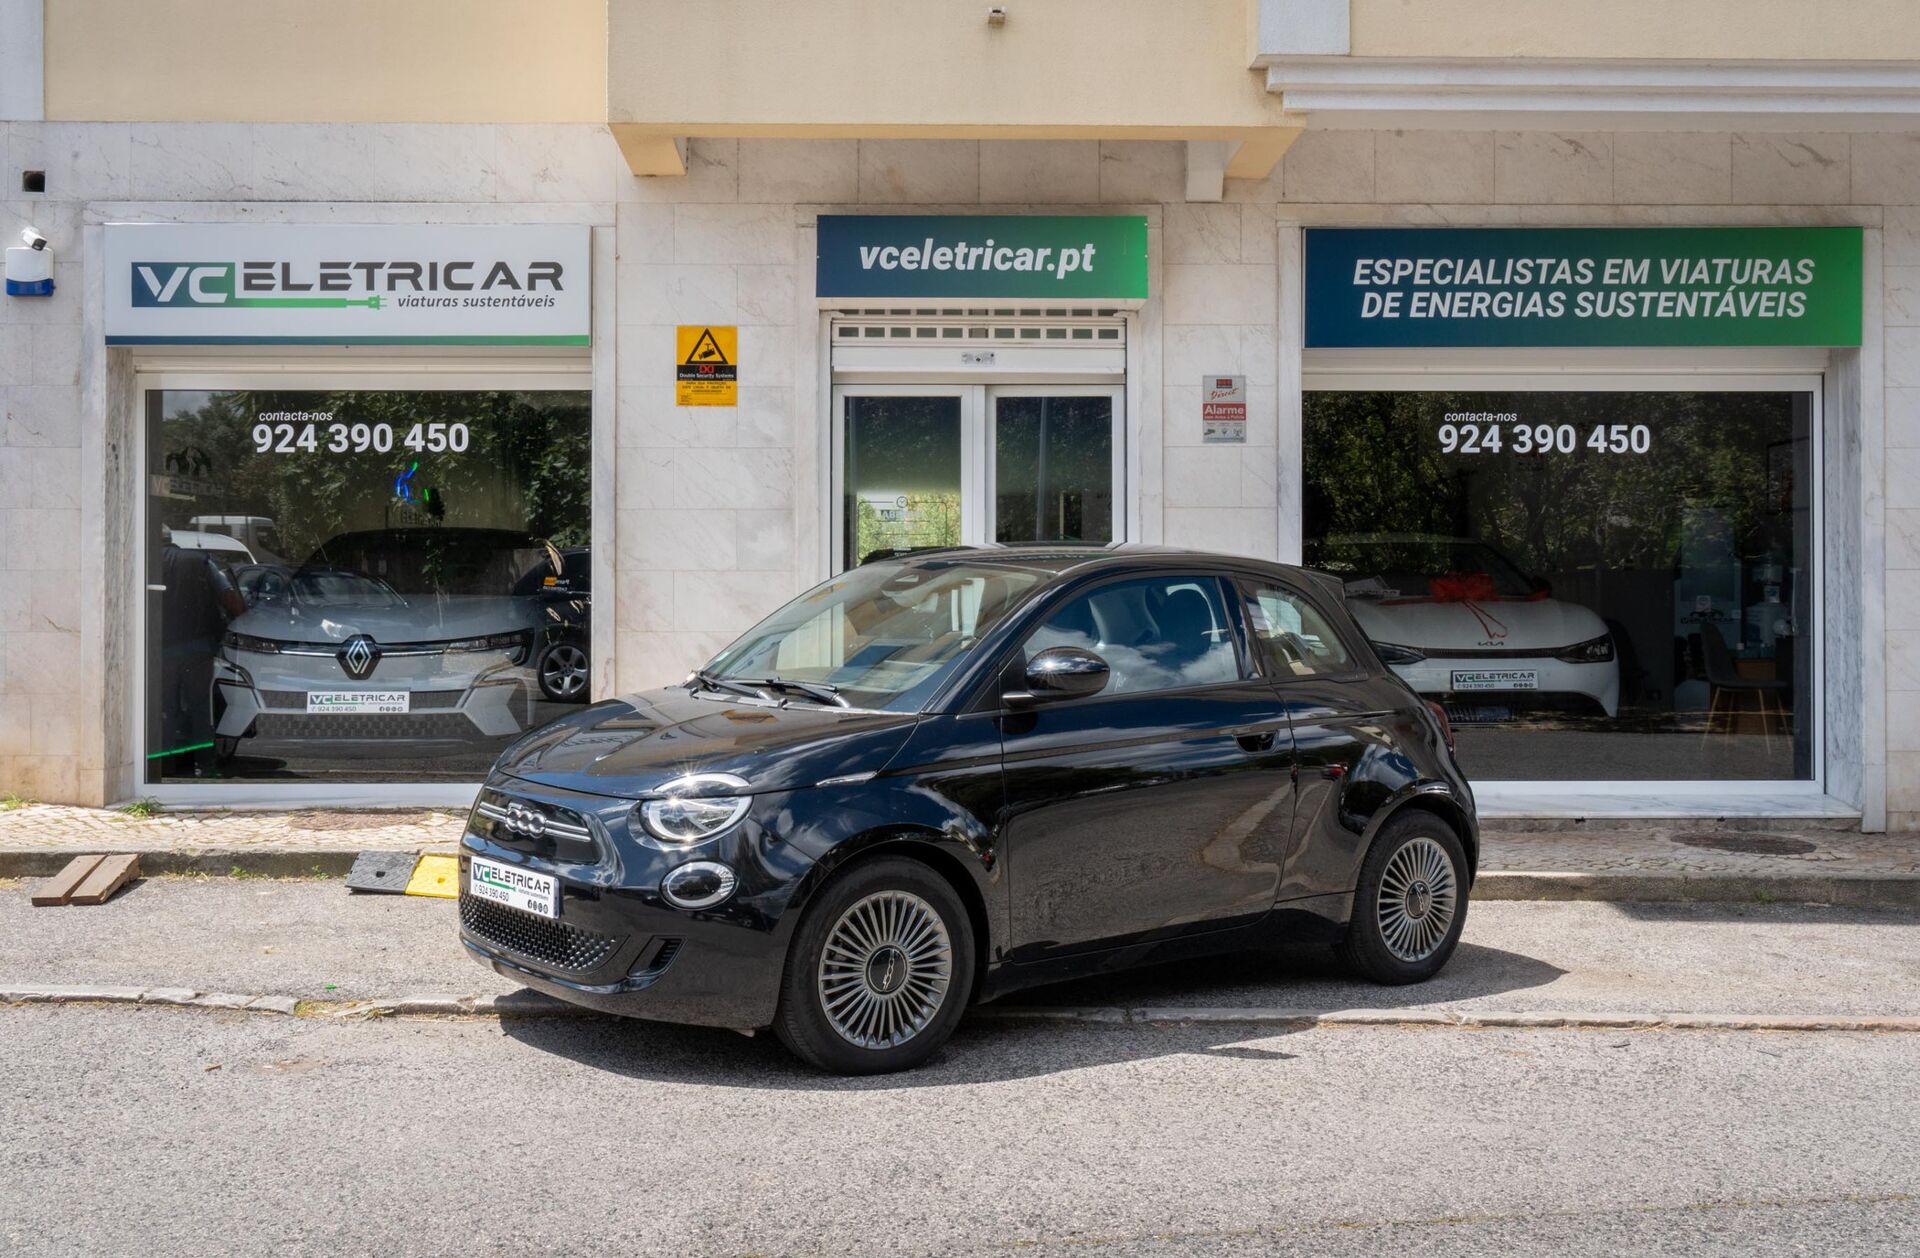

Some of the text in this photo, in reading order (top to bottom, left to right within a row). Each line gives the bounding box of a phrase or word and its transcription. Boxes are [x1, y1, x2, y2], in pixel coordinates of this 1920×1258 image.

[859, 238, 1096, 280] vceletricar.pt
[1353, 258, 1815, 285] ESPECIALISTAS EM VIATURAS
[397, 294, 556, 308] viaturas sustentáveis
[1361, 285, 1808, 318] DE ENERGIAS SUSTENTÁVEIS
[258, 410, 334, 423] contacta-nos
[1204, 404, 1244, 414] Alarme
[1444, 410, 1517, 423] contacta-nos
[252, 423, 470, 454] 924 390 450
[1438, 424, 1651, 455] 924 390 450
